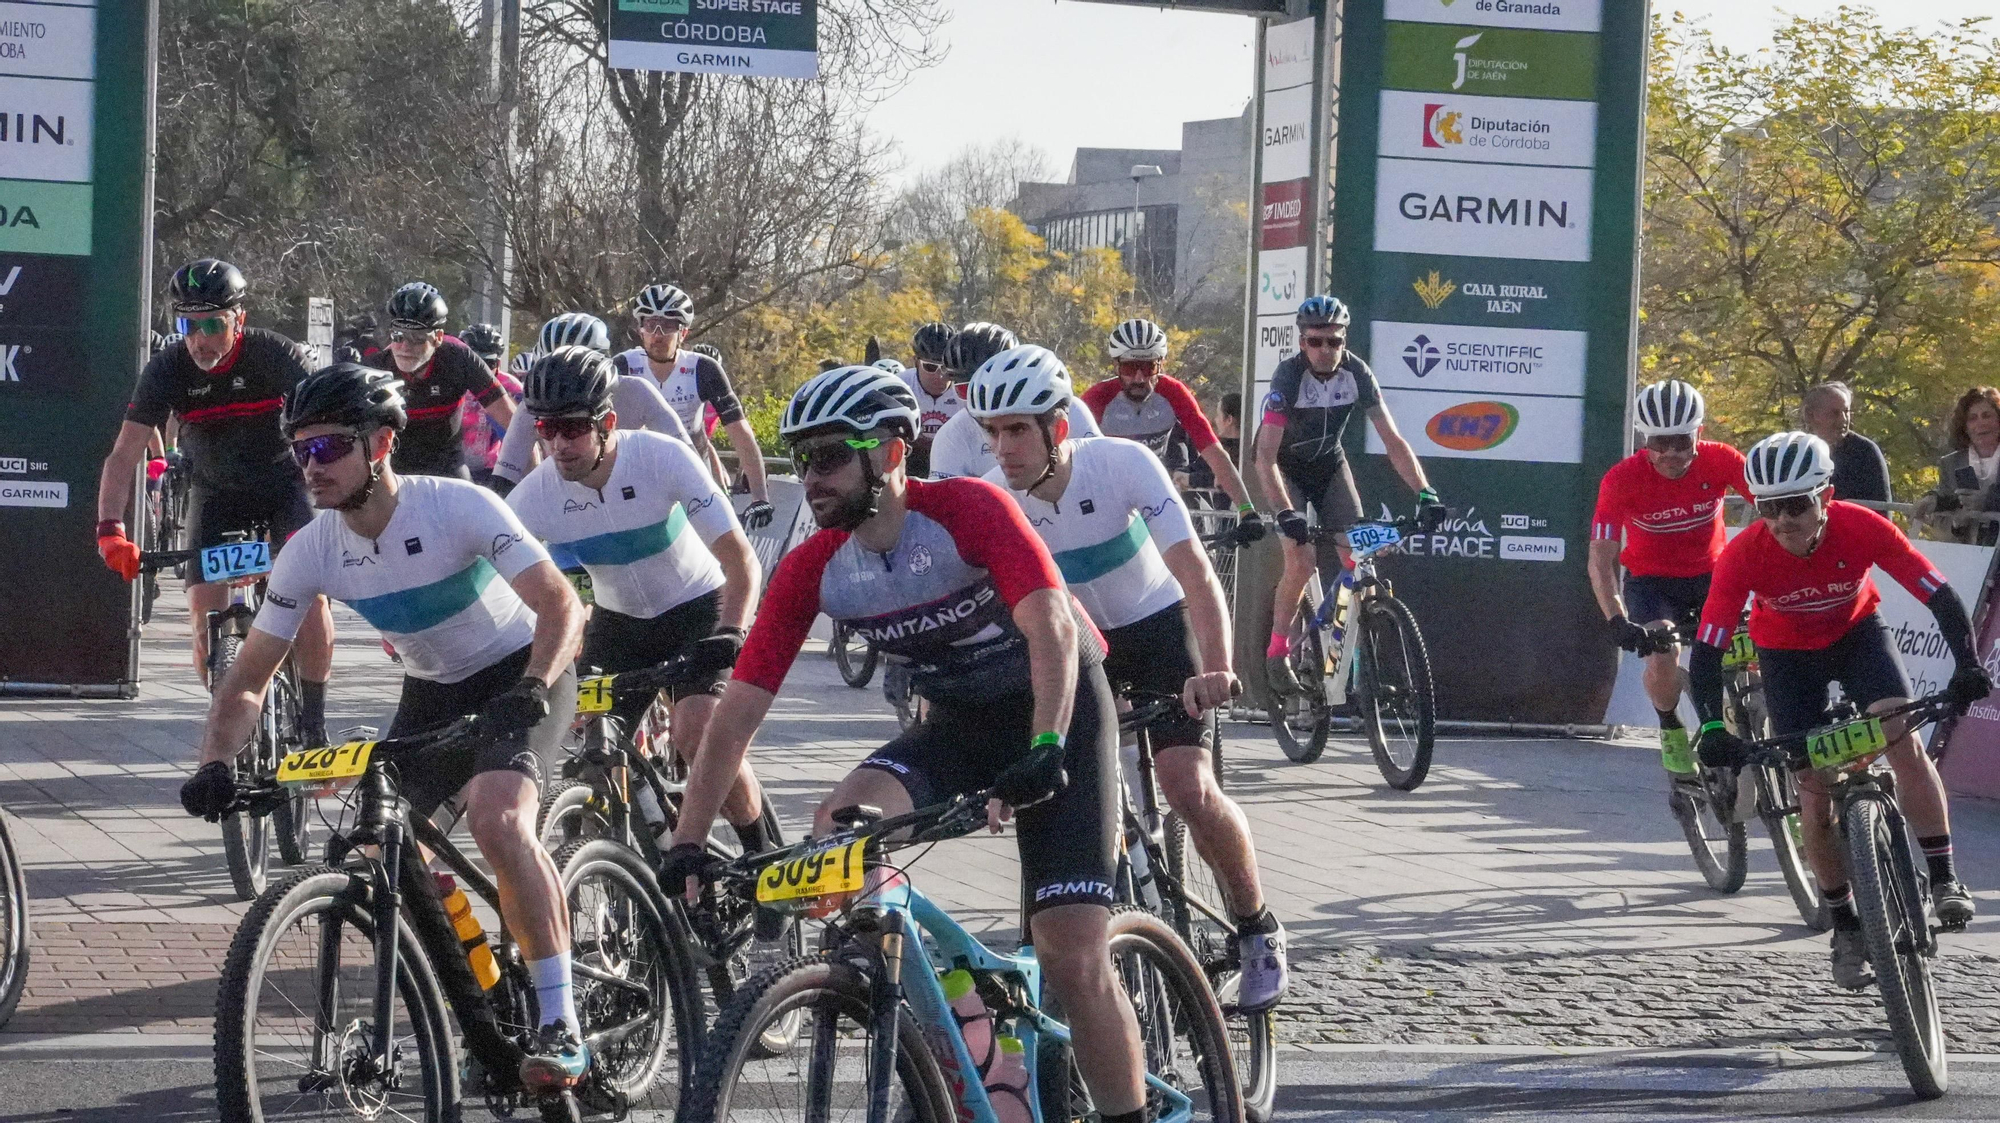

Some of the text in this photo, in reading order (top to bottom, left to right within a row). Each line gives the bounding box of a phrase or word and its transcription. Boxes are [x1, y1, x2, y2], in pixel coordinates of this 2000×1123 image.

[696, 0, 802, 15] SUPER STAGE
[1476, 0, 1560, 15] de Granada
[661, 19, 766, 44] CÓRDOBA
[677, 52, 751, 68] GARMIN
[1468, 58, 1528, 71] DIPUTACIÓN
[1467, 70, 1507, 81] DE JAÉN
[0, 112, 64, 145] IN
[1471, 117, 1550, 134] Diputación
[1264, 122, 1305, 147] GARMIN
[1469, 135, 1551, 150] de Córdoba
[0, 205, 40, 229] A
[1399, 192, 1568, 228] GARMIN
[1462, 282, 1548, 299] CAJA RURAL
[1487, 299, 1523, 314] JAÉN
[1446, 342, 1544, 359] SCIENTIFFIC
[1446, 359, 1533, 375] NUTRITION
[0, 460, 49, 471] UCI SHC
[2, 488, 60, 500] GARMIN
[1643, 507, 1688, 521] COSTA
[1505, 517, 1548, 528] UCI SHC
[1351, 527, 1397, 552] 509-2
[1431, 535, 1495, 559] RACE
[1507, 543, 1558, 553] GARMIN
[207, 542, 267, 575] 512-2
[1813, 721, 1877, 759] 411-1
[795, 884, 827, 896] RAMIREZ
[1035, 880, 1115, 903] ERMITA
